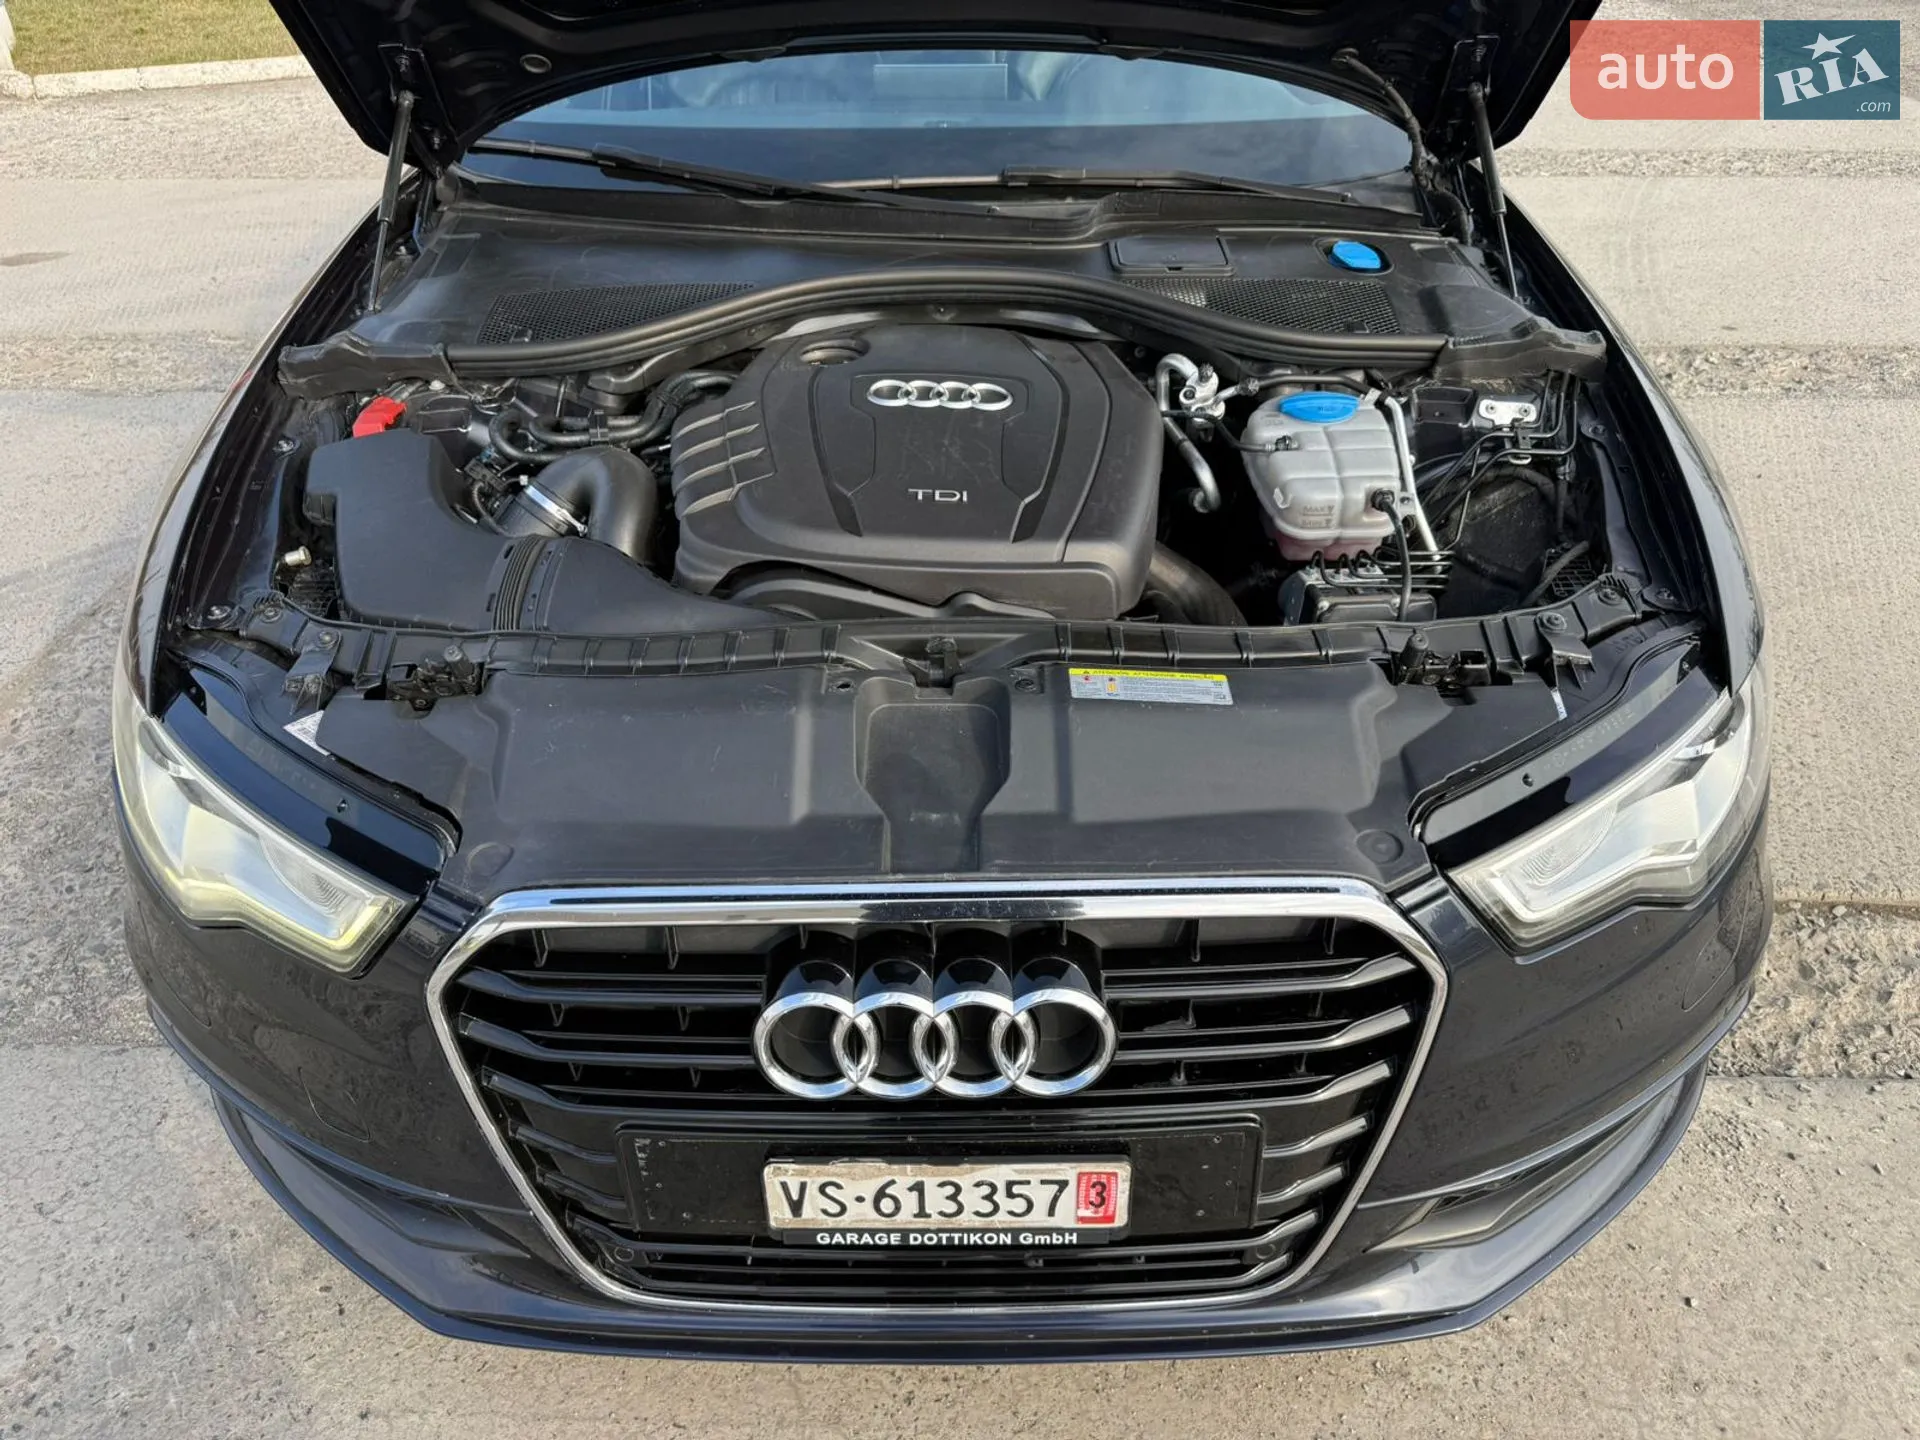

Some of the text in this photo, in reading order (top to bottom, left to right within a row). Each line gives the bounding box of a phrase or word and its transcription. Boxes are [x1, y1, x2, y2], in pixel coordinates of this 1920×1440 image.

[907, 488, 968, 502] TDI
[1088, 1181, 1107, 1209] 3
[816, 1232, 1078, 1245] GARAGE DOTTIKON GmbH
